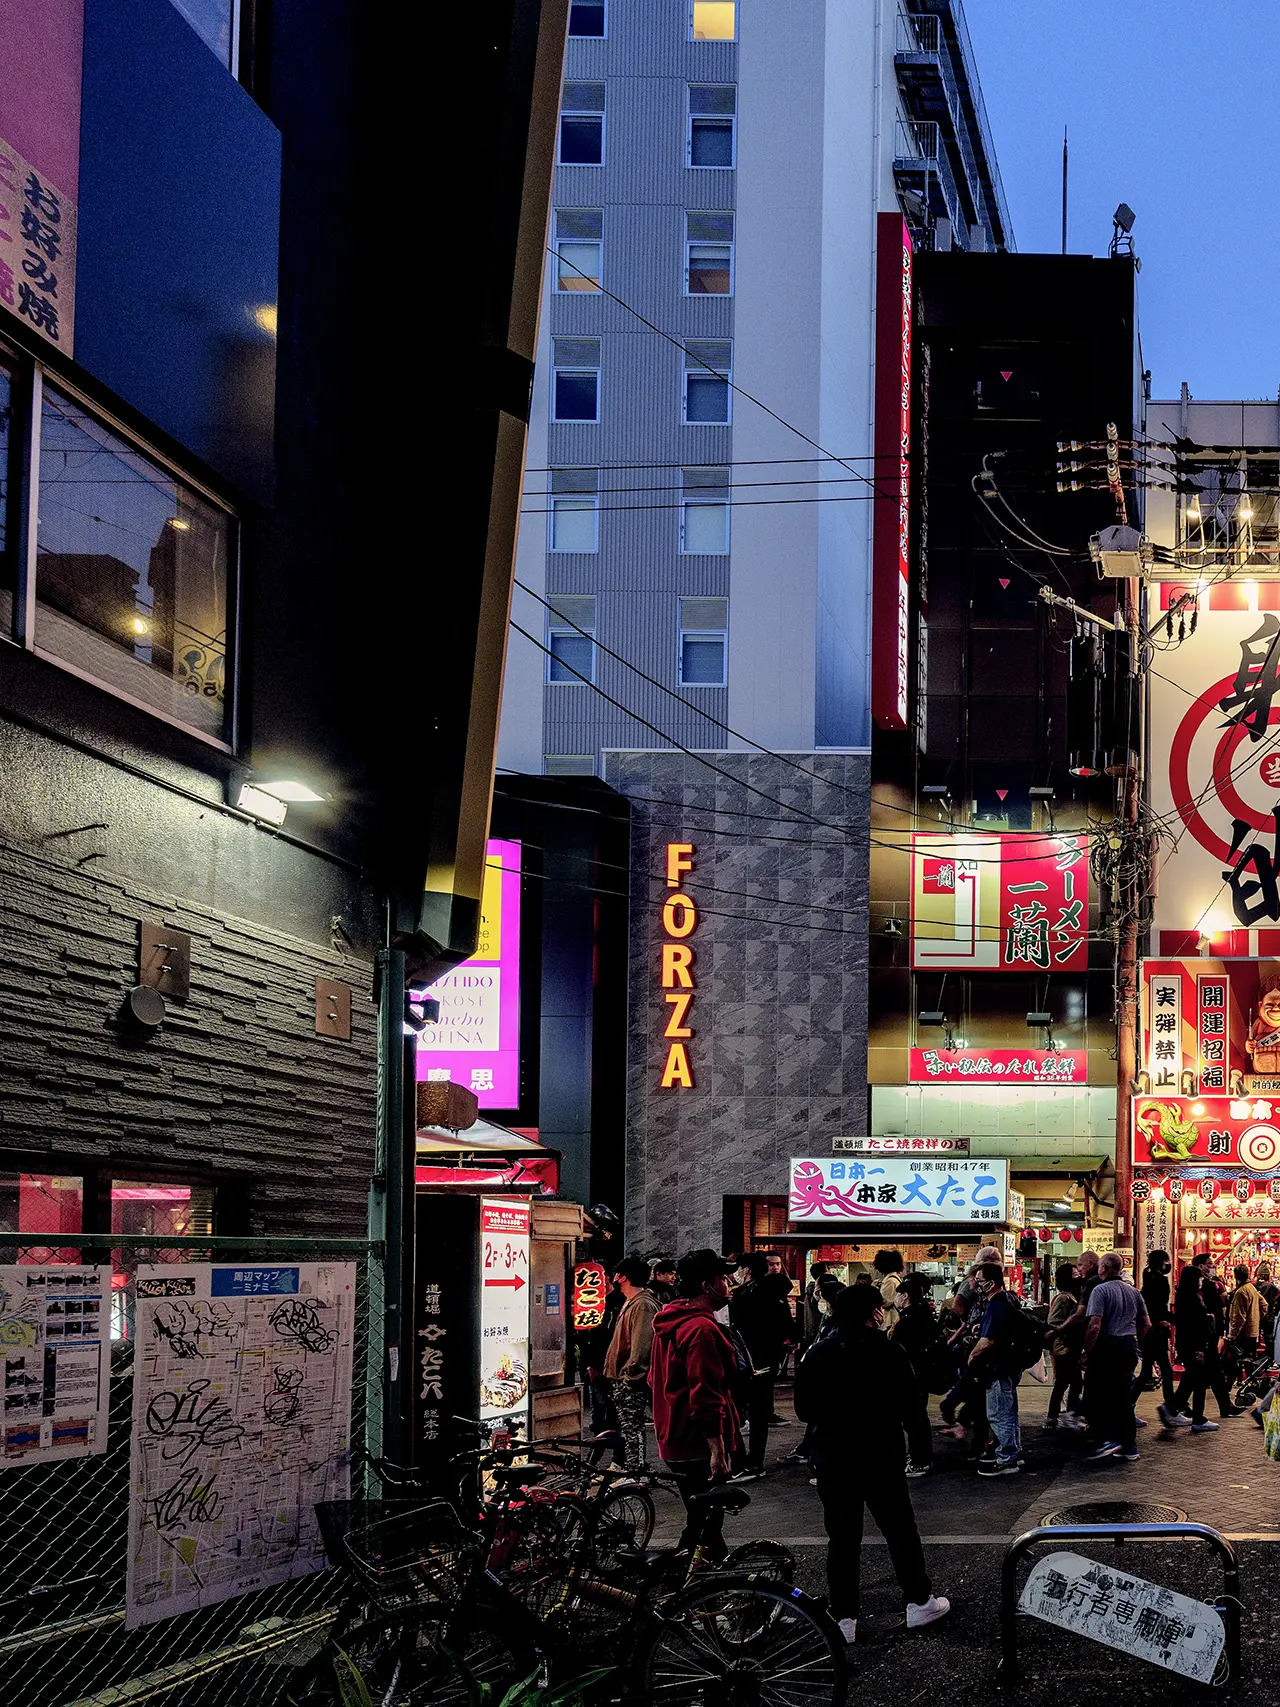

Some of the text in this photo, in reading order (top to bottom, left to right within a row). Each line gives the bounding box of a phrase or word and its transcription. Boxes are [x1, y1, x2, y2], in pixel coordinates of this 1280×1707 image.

[18, 172, 62, 341] お好み焼
[923, 865, 955, 888] 一蘭
[958, 861, 978, 871] 入口
[1052, 838, 1084, 963] ラーメン
[1005, 881, 1051, 968] 一蘭
[661, 843, 696, 1088] FORZA
[1155, 986, 1176, 1087] 実弾禁止
[1202, 986, 1224, 1088] 開運招福
[834, 1138, 968, 1150] 道頓堀 たこ焼発祥の店
[829, 1162, 885, 1180] 日本一
[909, 1161, 990, 1172] 創業昭和47年
[857, 1173, 1000, 1207] 本家 大たこ
[1131, 1181, 1150, 1199] 祭
[970, 1209, 1000, 1219] 道頓堀
[234, 1271, 280, 1282] 周辺マップ
[425, 1283, 442, 1314] 道頓堀
[575, 1268, 604, 1326] たこ焼
[420, 1346, 444, 1400] たこ八
[423, 1409, 439, 1440] 総本店
